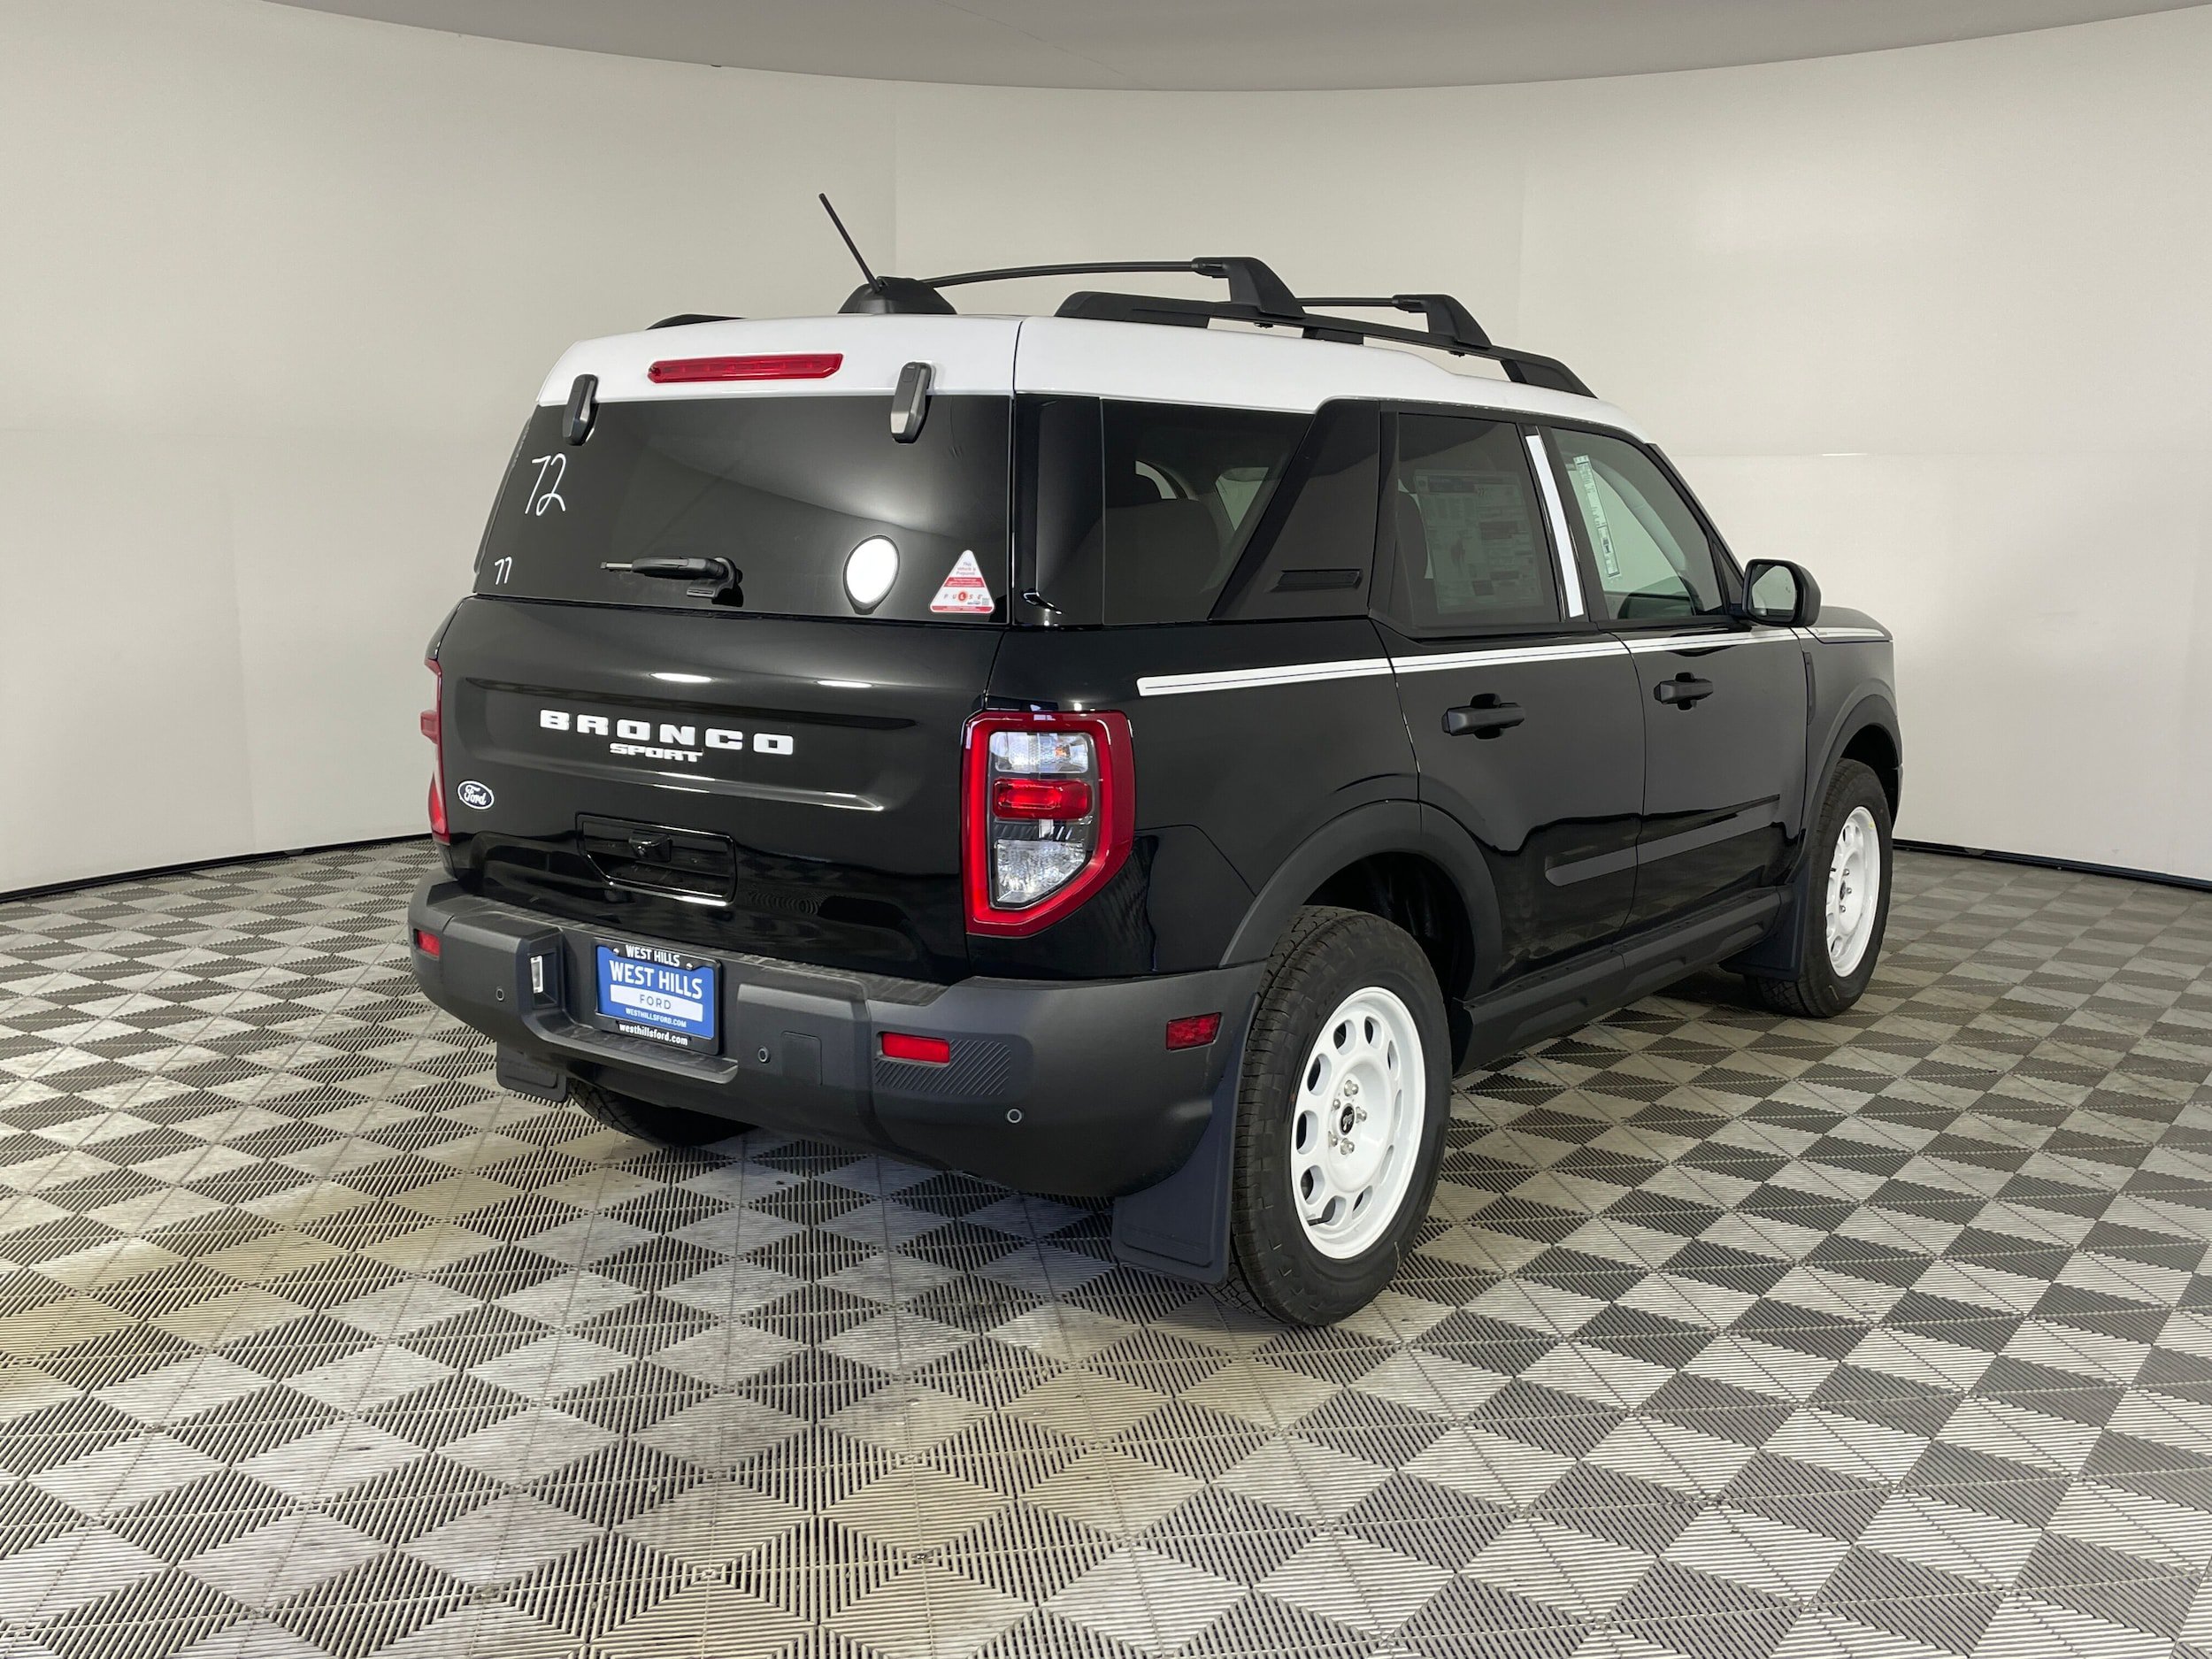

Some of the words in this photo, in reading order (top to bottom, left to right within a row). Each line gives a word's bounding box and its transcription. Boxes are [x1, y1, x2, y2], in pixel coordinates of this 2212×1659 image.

[524, 452, 566, 516] 72
[540, 709, 794, 756] BRONCO
[610, 742, 703, 763] SPORT
[464, 784, 487, 805] Ford
[626, 944, 652, 960] WEST
[654, 949, 680, 967] HILLS
[609, 960, 655, 987] WEST
[658, 970, 703, 1000] HILLS
[639, 994, 672, 1010] FORD
[626, 1007, 687, 1028] WESTHILLSFORD.COM
[619, 1023, 688, 1046] westhillsford.com
